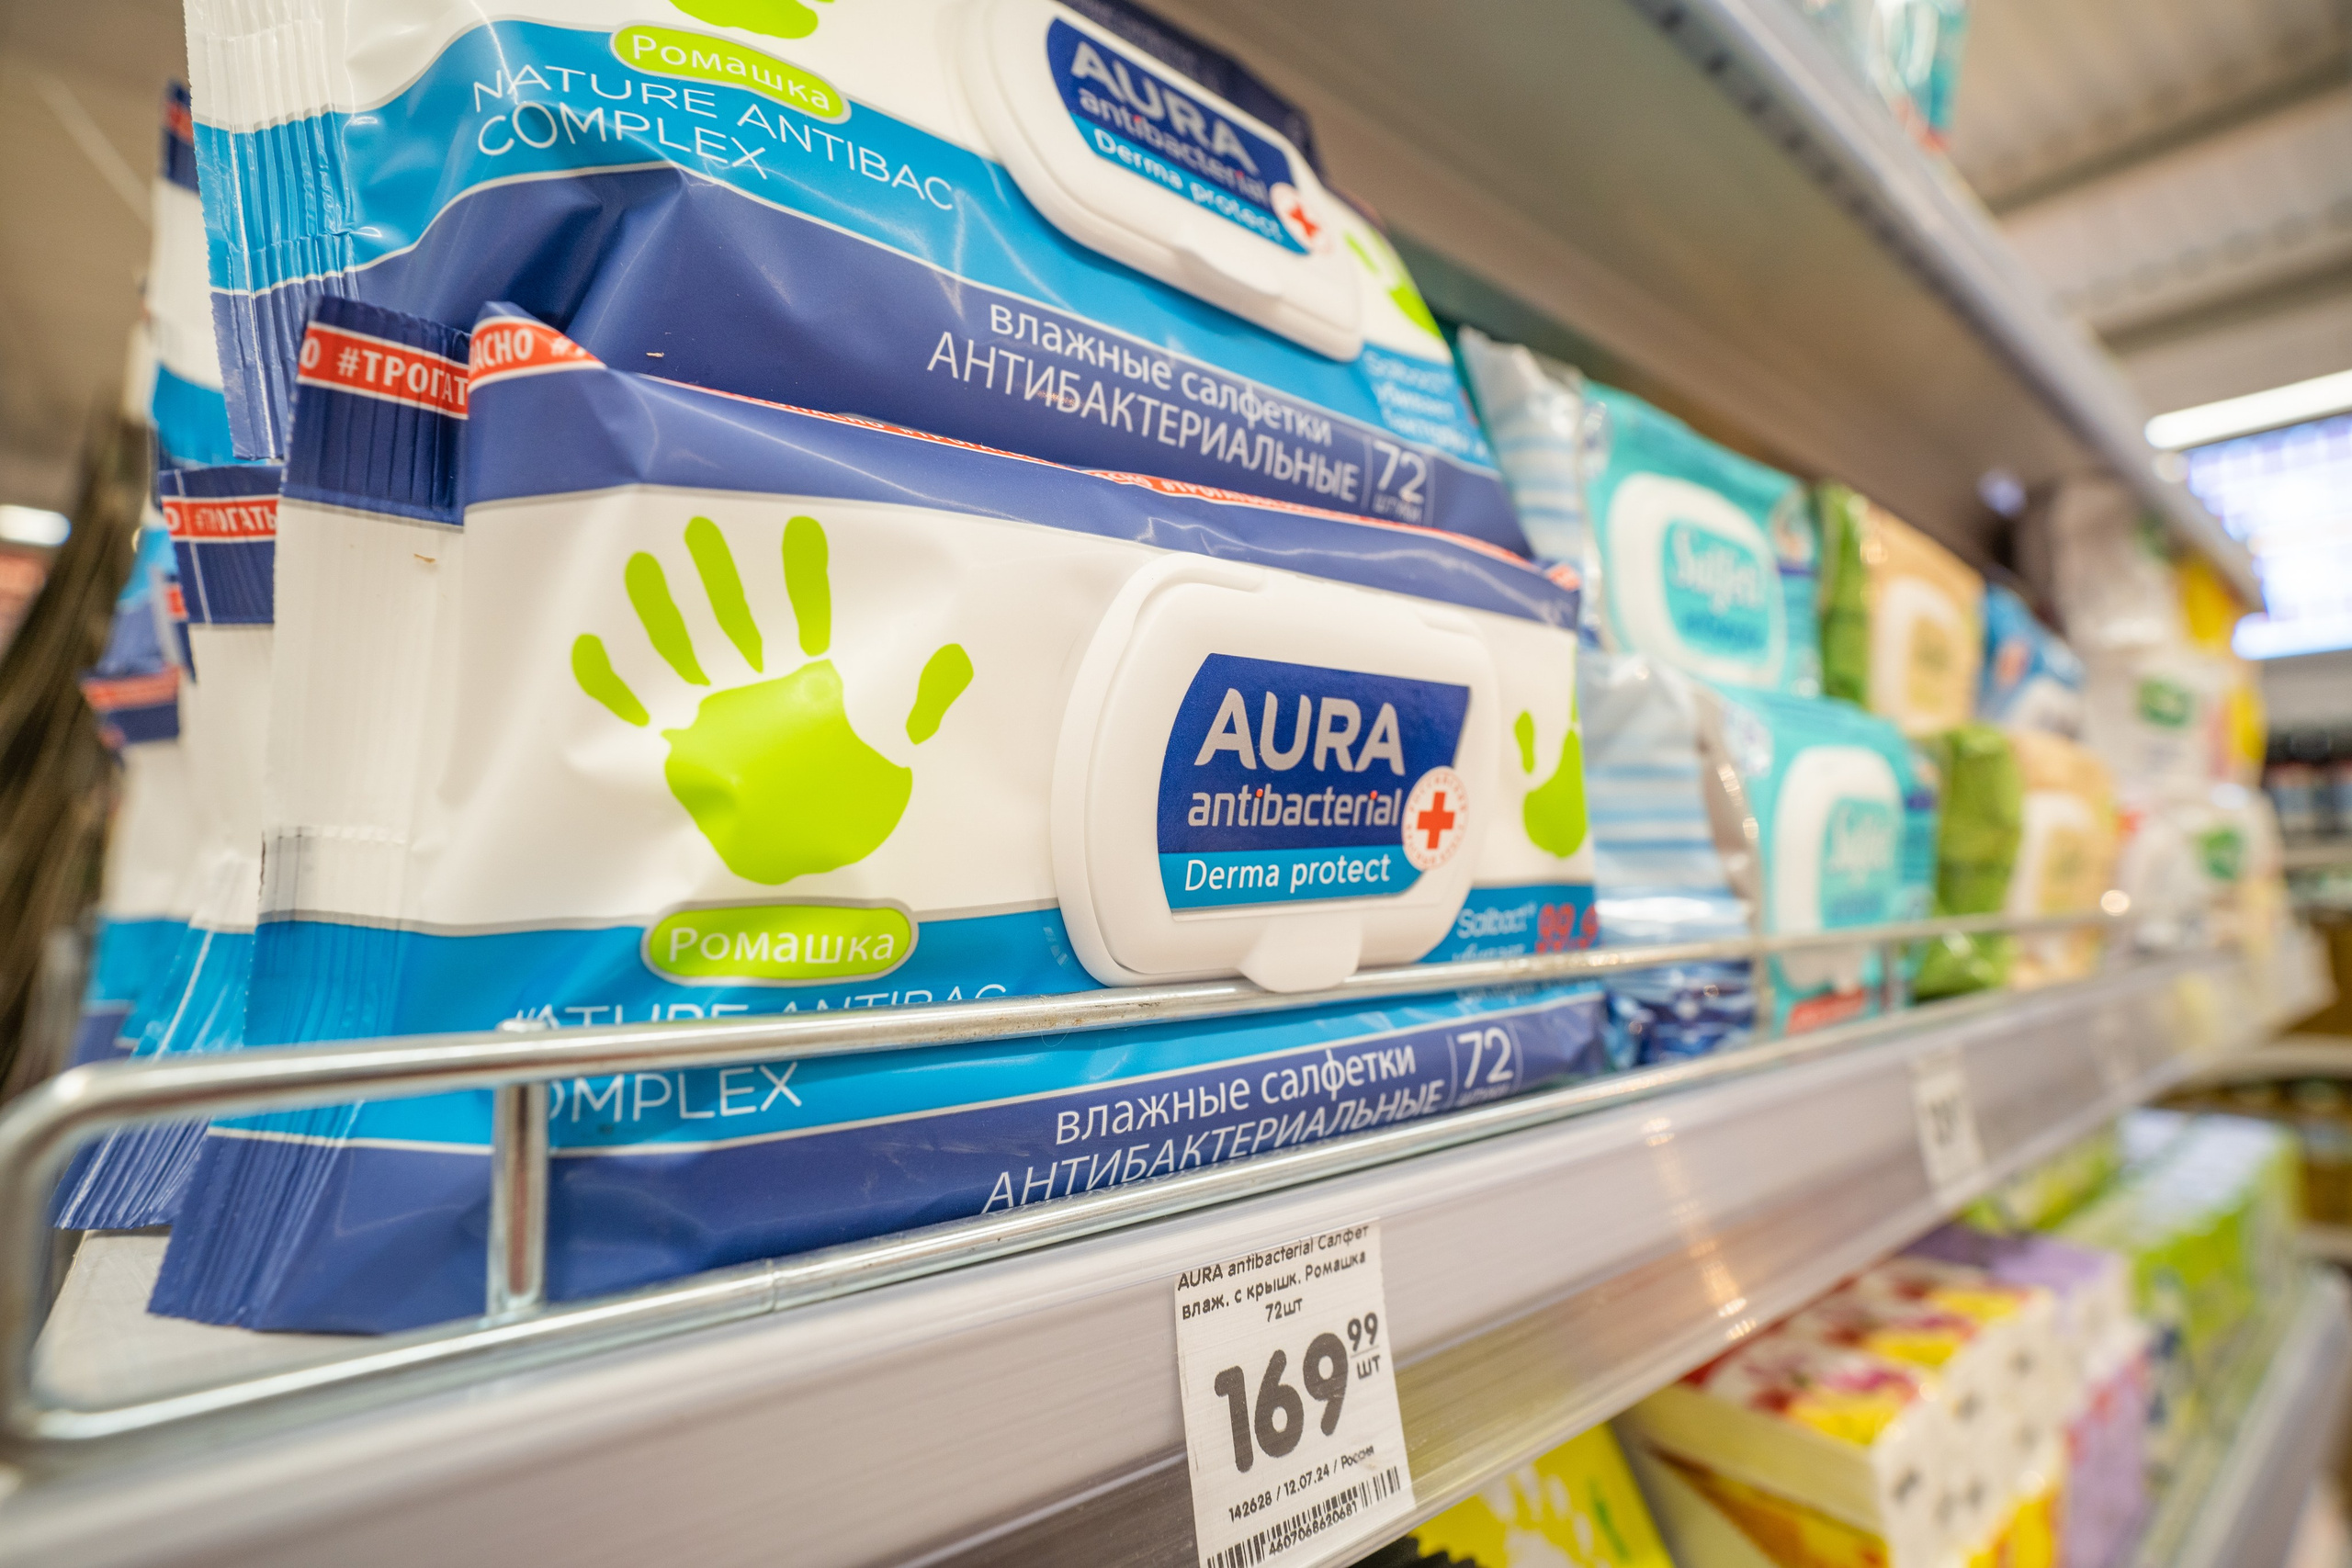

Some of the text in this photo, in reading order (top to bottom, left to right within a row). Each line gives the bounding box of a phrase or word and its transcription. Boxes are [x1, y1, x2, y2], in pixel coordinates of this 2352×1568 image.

[633, 33, 831, 111] Ромашка
[1070, 40, 1260, 175] AURA
[473, 63, 954, 211] NATURE ANTIBAC
[477, 101, 768, 180] COMPLEX
[1077, 87, 1269, 205] antibacterial
[1092, 128, 1284, 243] Derma protect
[989, 303, 1172, 391] влажные
[1180, 367, 1332, 446] салфетки
[926, 331, 1360, 503] АНТИБАКТЕРИАЛЬНЫЕ
[1372, 438, 1428, 504] 72
[1193, 687, 1406, 775] AURA
[1187, 783, 1403, 828] antibacterial
[1184, 853, 1392, 894] Derma protect
[669, 924, 895, 964] Ромашка
[1057, 1045, 1416, 1145] влажные салфетки
[1456, 1026, 1515, 1089] 72
[980, 1079, 1445, 1213] АНТИБАКТЕРИАЛЬНЫЕ
[1178, 1225, 1369, 1292] AURA antibacterial Салфет
[1182, 1250, 1366, 1321] влаж. с крышк. Ромашка
[1265, 1297, 1303, 1323] 72шт
[1214, 1312, 1378, 1473] 169 99
[1228, 1491, 1272, 1523] 142628
[1283, 1463, 1330, 1496] 12.07.24
[1269, 1500, 1358, 1556] 4607068620681
